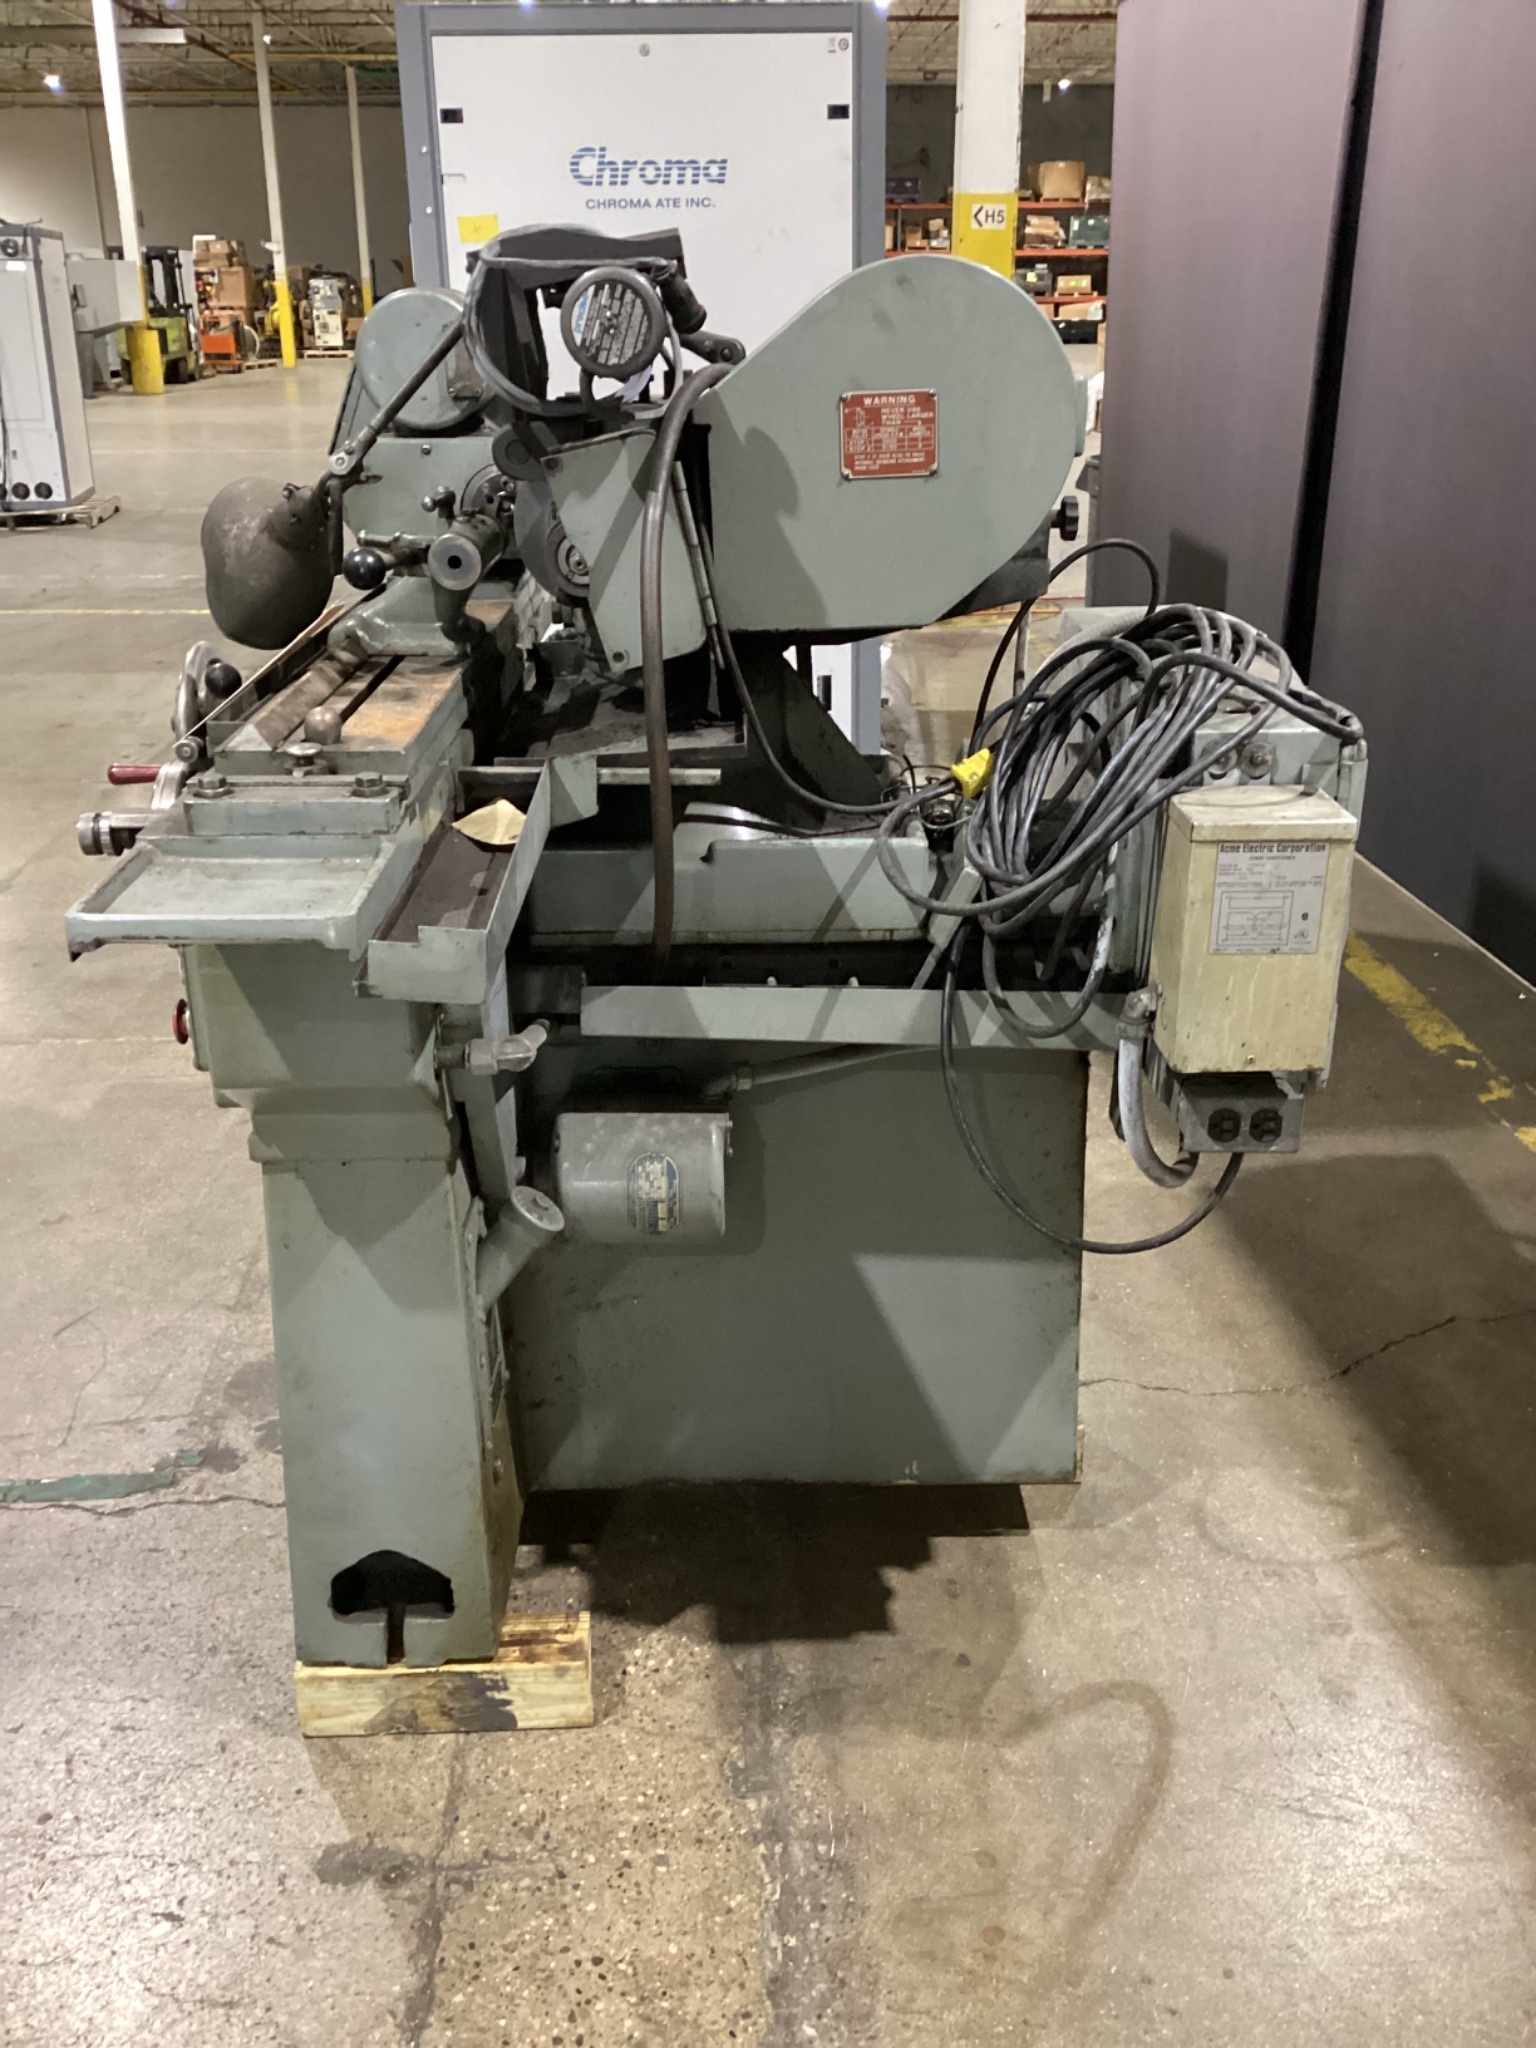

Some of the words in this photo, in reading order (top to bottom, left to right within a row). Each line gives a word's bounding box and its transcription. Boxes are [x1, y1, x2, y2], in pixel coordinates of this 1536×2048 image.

[569, 146, 728, 186] Chroma
[585, 198, 651, 210] CHROMA
[656, 198, 681, 209] ATE
[685, 197, 716, 209] INC.
[863, 395, 916, 405] WARNING
[1220, 843, 1241, 853] Acme
[1242, 843, 1275, 853] Electric
[1276, 843, 1326, 853] Corporation
